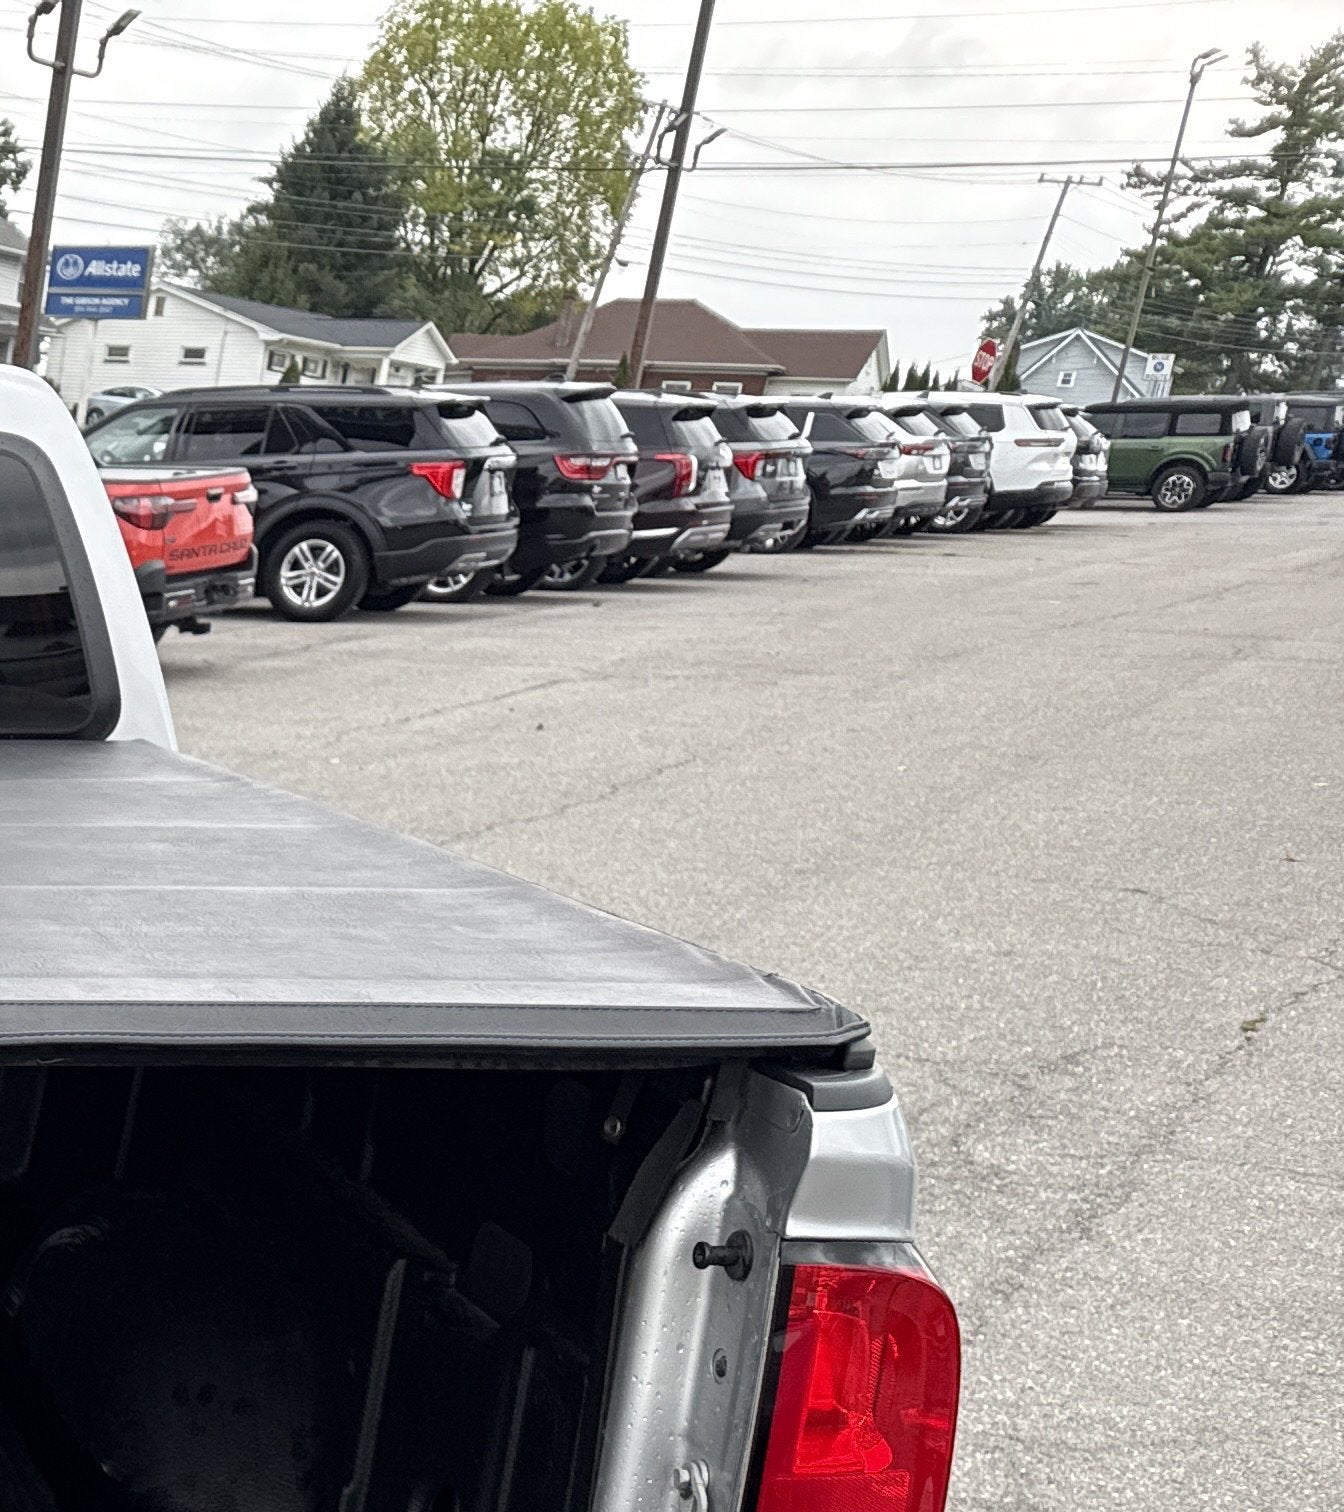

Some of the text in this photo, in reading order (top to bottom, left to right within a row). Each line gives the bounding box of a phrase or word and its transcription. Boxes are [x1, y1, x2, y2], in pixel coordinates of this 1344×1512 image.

[84, 259, 142, 277] Allstate
[973, 350, 995, 371] STOP
[169, 544, 218, 561] SANTA
